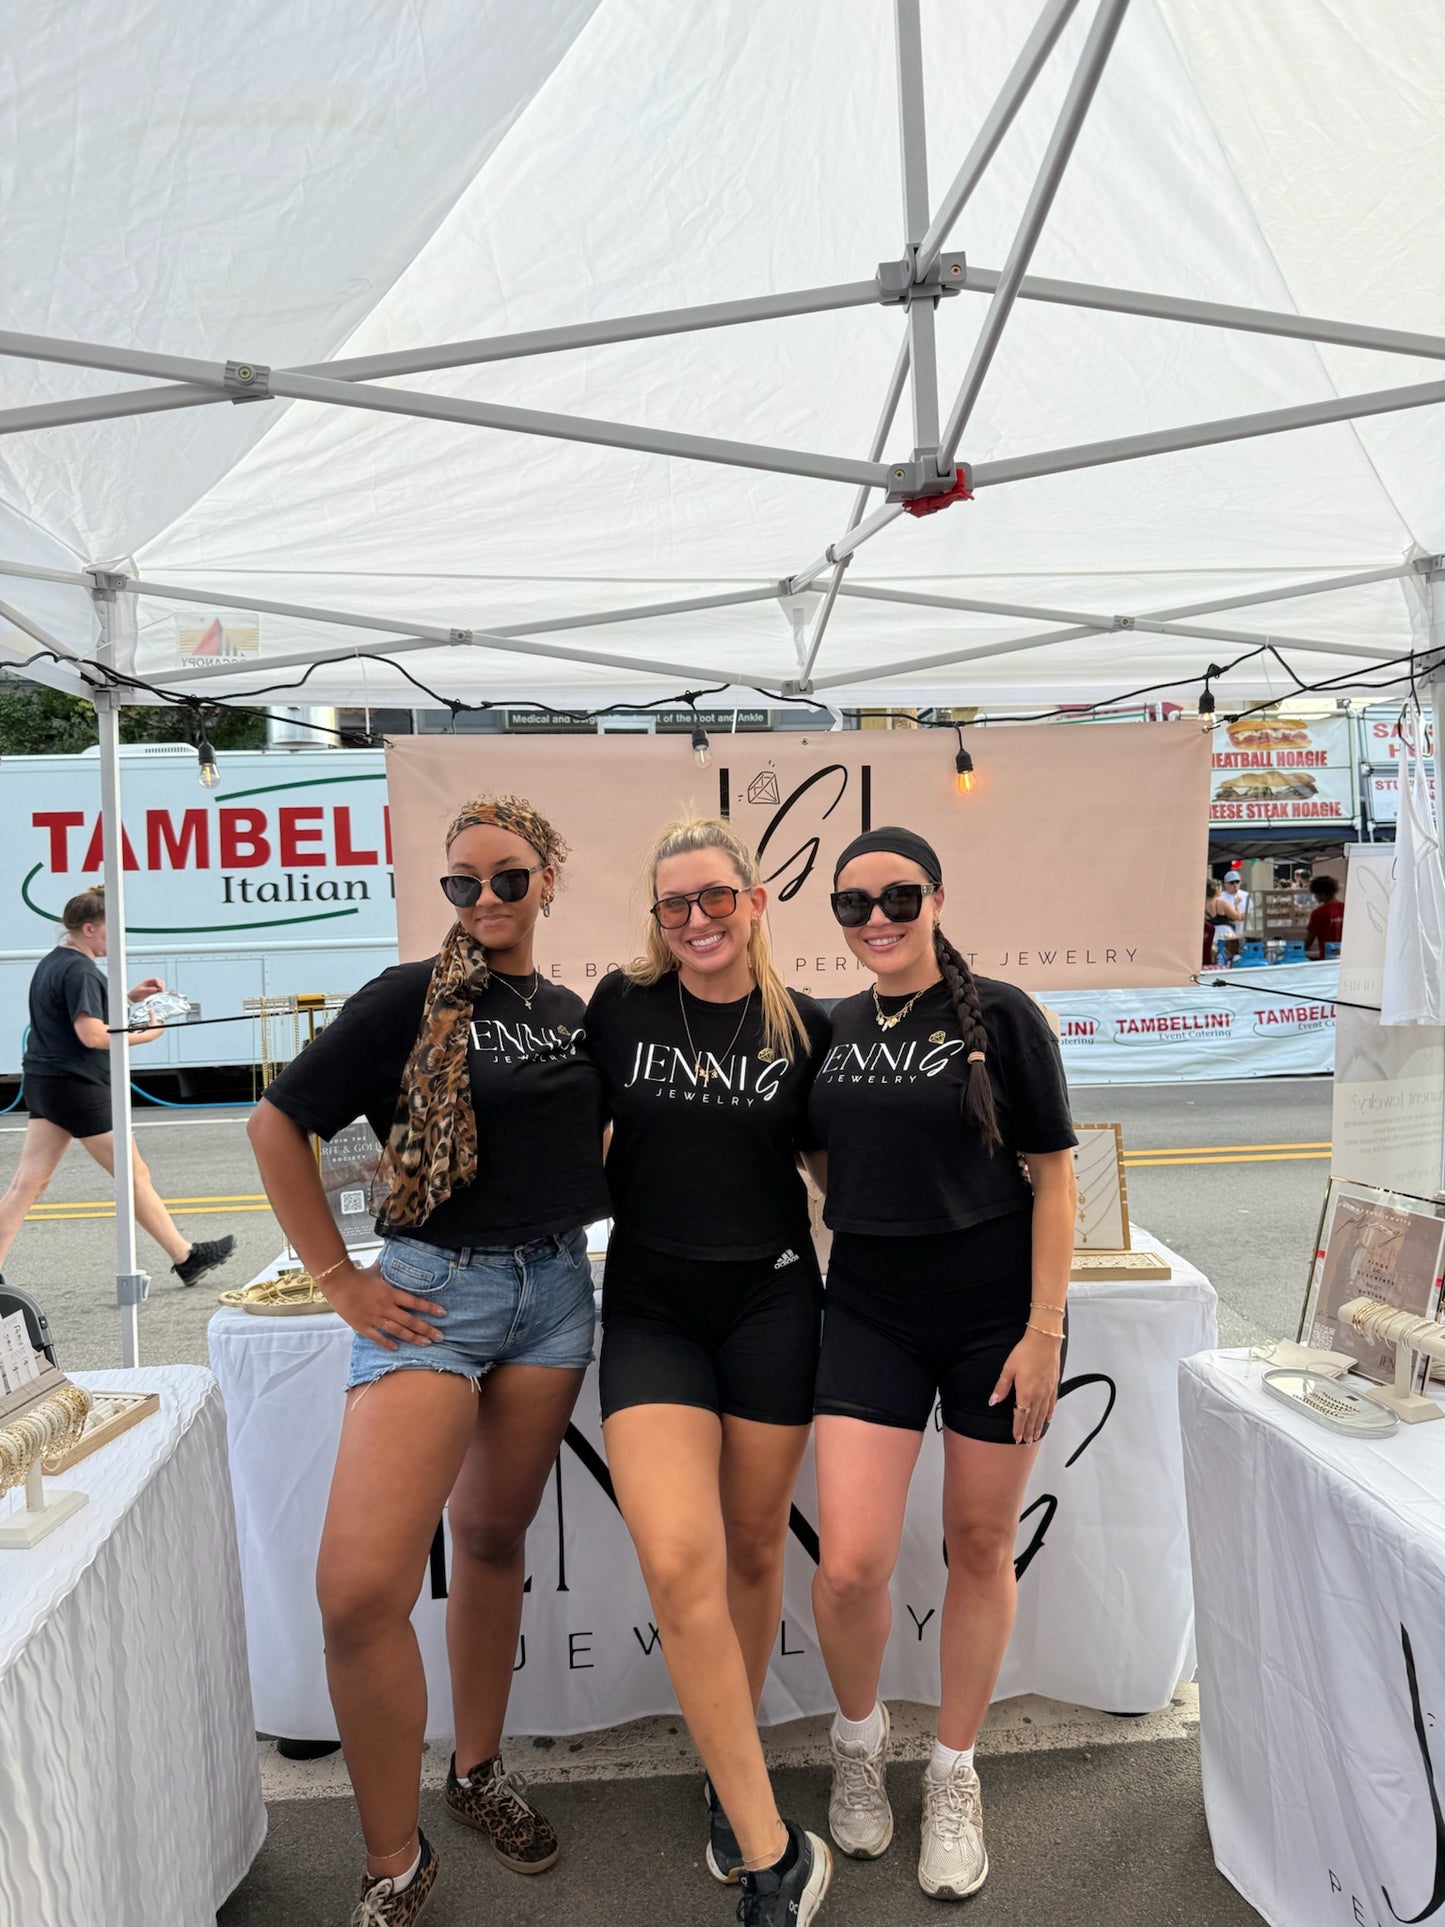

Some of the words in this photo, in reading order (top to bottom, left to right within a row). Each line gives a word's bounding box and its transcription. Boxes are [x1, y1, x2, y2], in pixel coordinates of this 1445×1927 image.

[512, 714, 549, 724] Medical
[552, 714, 571, 724] and
[663, 714, 673, 723] of
[676, 713, 692, 723] the
[738, 712, 764, 722] Ankle
[1276, 750, 1328, 767] HOAGIE
[1246, 802, 1289, 819] STEAK
[1292, 801, 1342, 818] HOAGIE
[32, 806, 393, 873] TAMBEL
[222, 873, 371, 904] Italian
[1000, 948, 1137, 966] JEWELRY
[1116, 1013, 1230, 1034] TAMBELLINI
[1159, 1031, 1185, 1041] Event
[1188, 1029, 1232, 1038] Catering
[827, 1074, 918, 1084] JEWELRY
[655, 1087, 754, 1107] JEWELRY
[322, 1145, 339, 1156] RIT
[342, 1144, 351, 1154] &
[332, 1154, 366, 1163] SOCIETY
